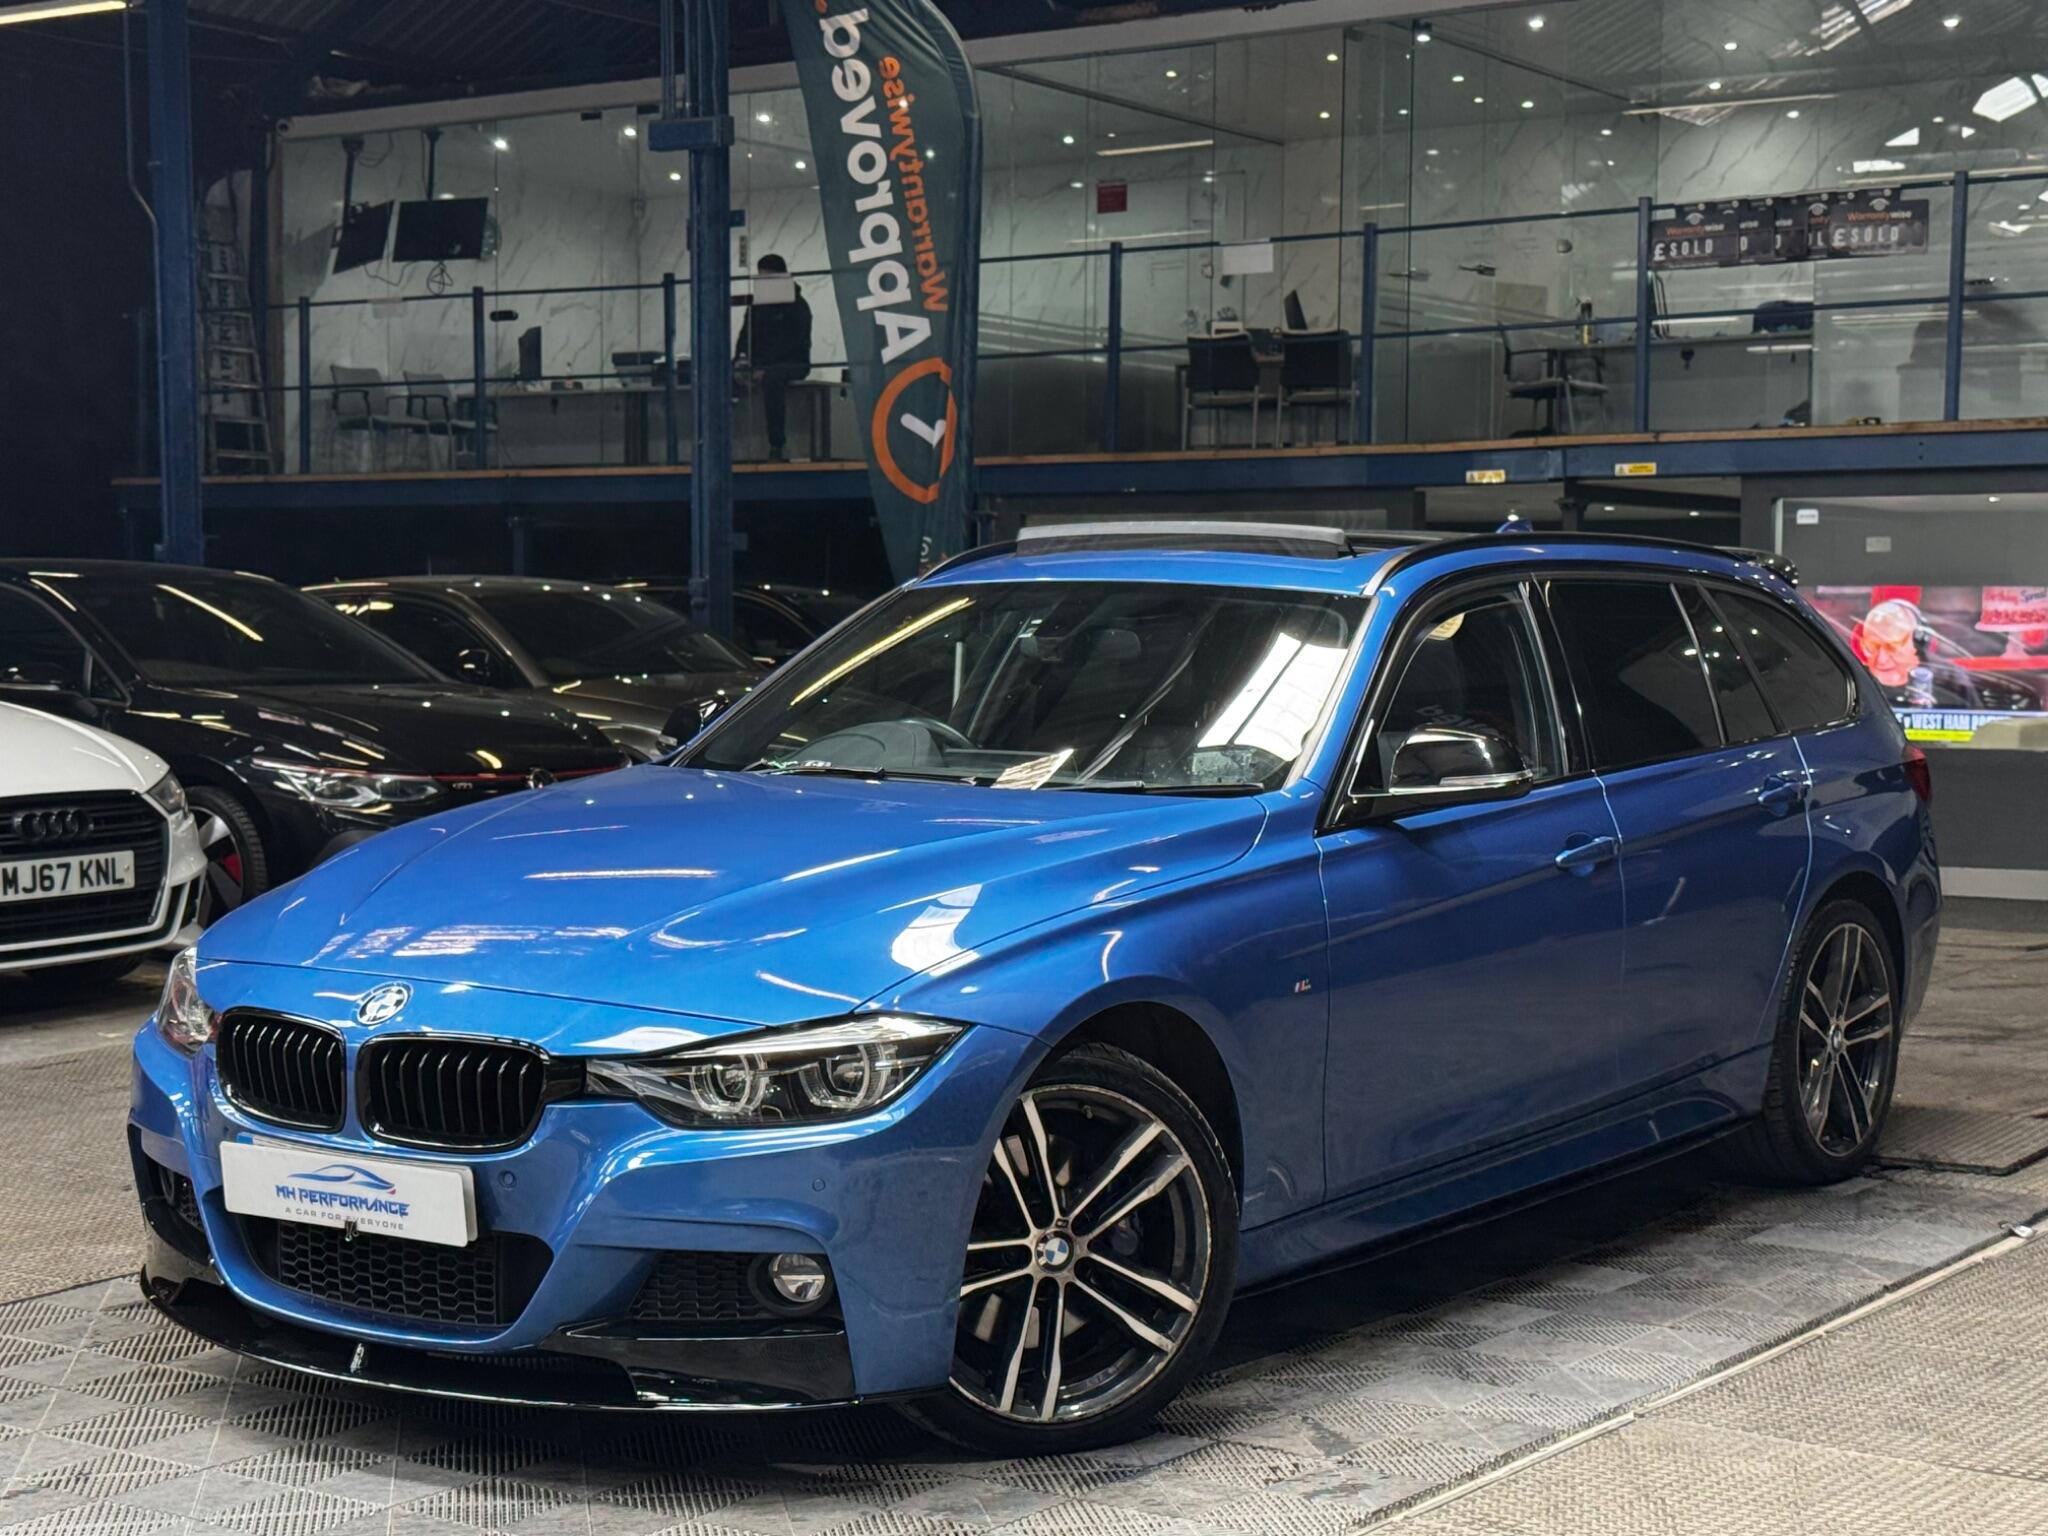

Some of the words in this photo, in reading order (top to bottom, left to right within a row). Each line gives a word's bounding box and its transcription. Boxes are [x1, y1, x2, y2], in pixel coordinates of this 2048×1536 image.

[1911, 713, 1943, 729] WEST
[1943, 714, 1970, 730] HAM
[2, 863, 71, 896] MJ67
[79, 857, 125, 888] KNL
[295, 1208, 317, 1217] CAR
[321, 1212, 342, 1220] FOR
[298, 1188, 410, 1218] PERFORMANCE
